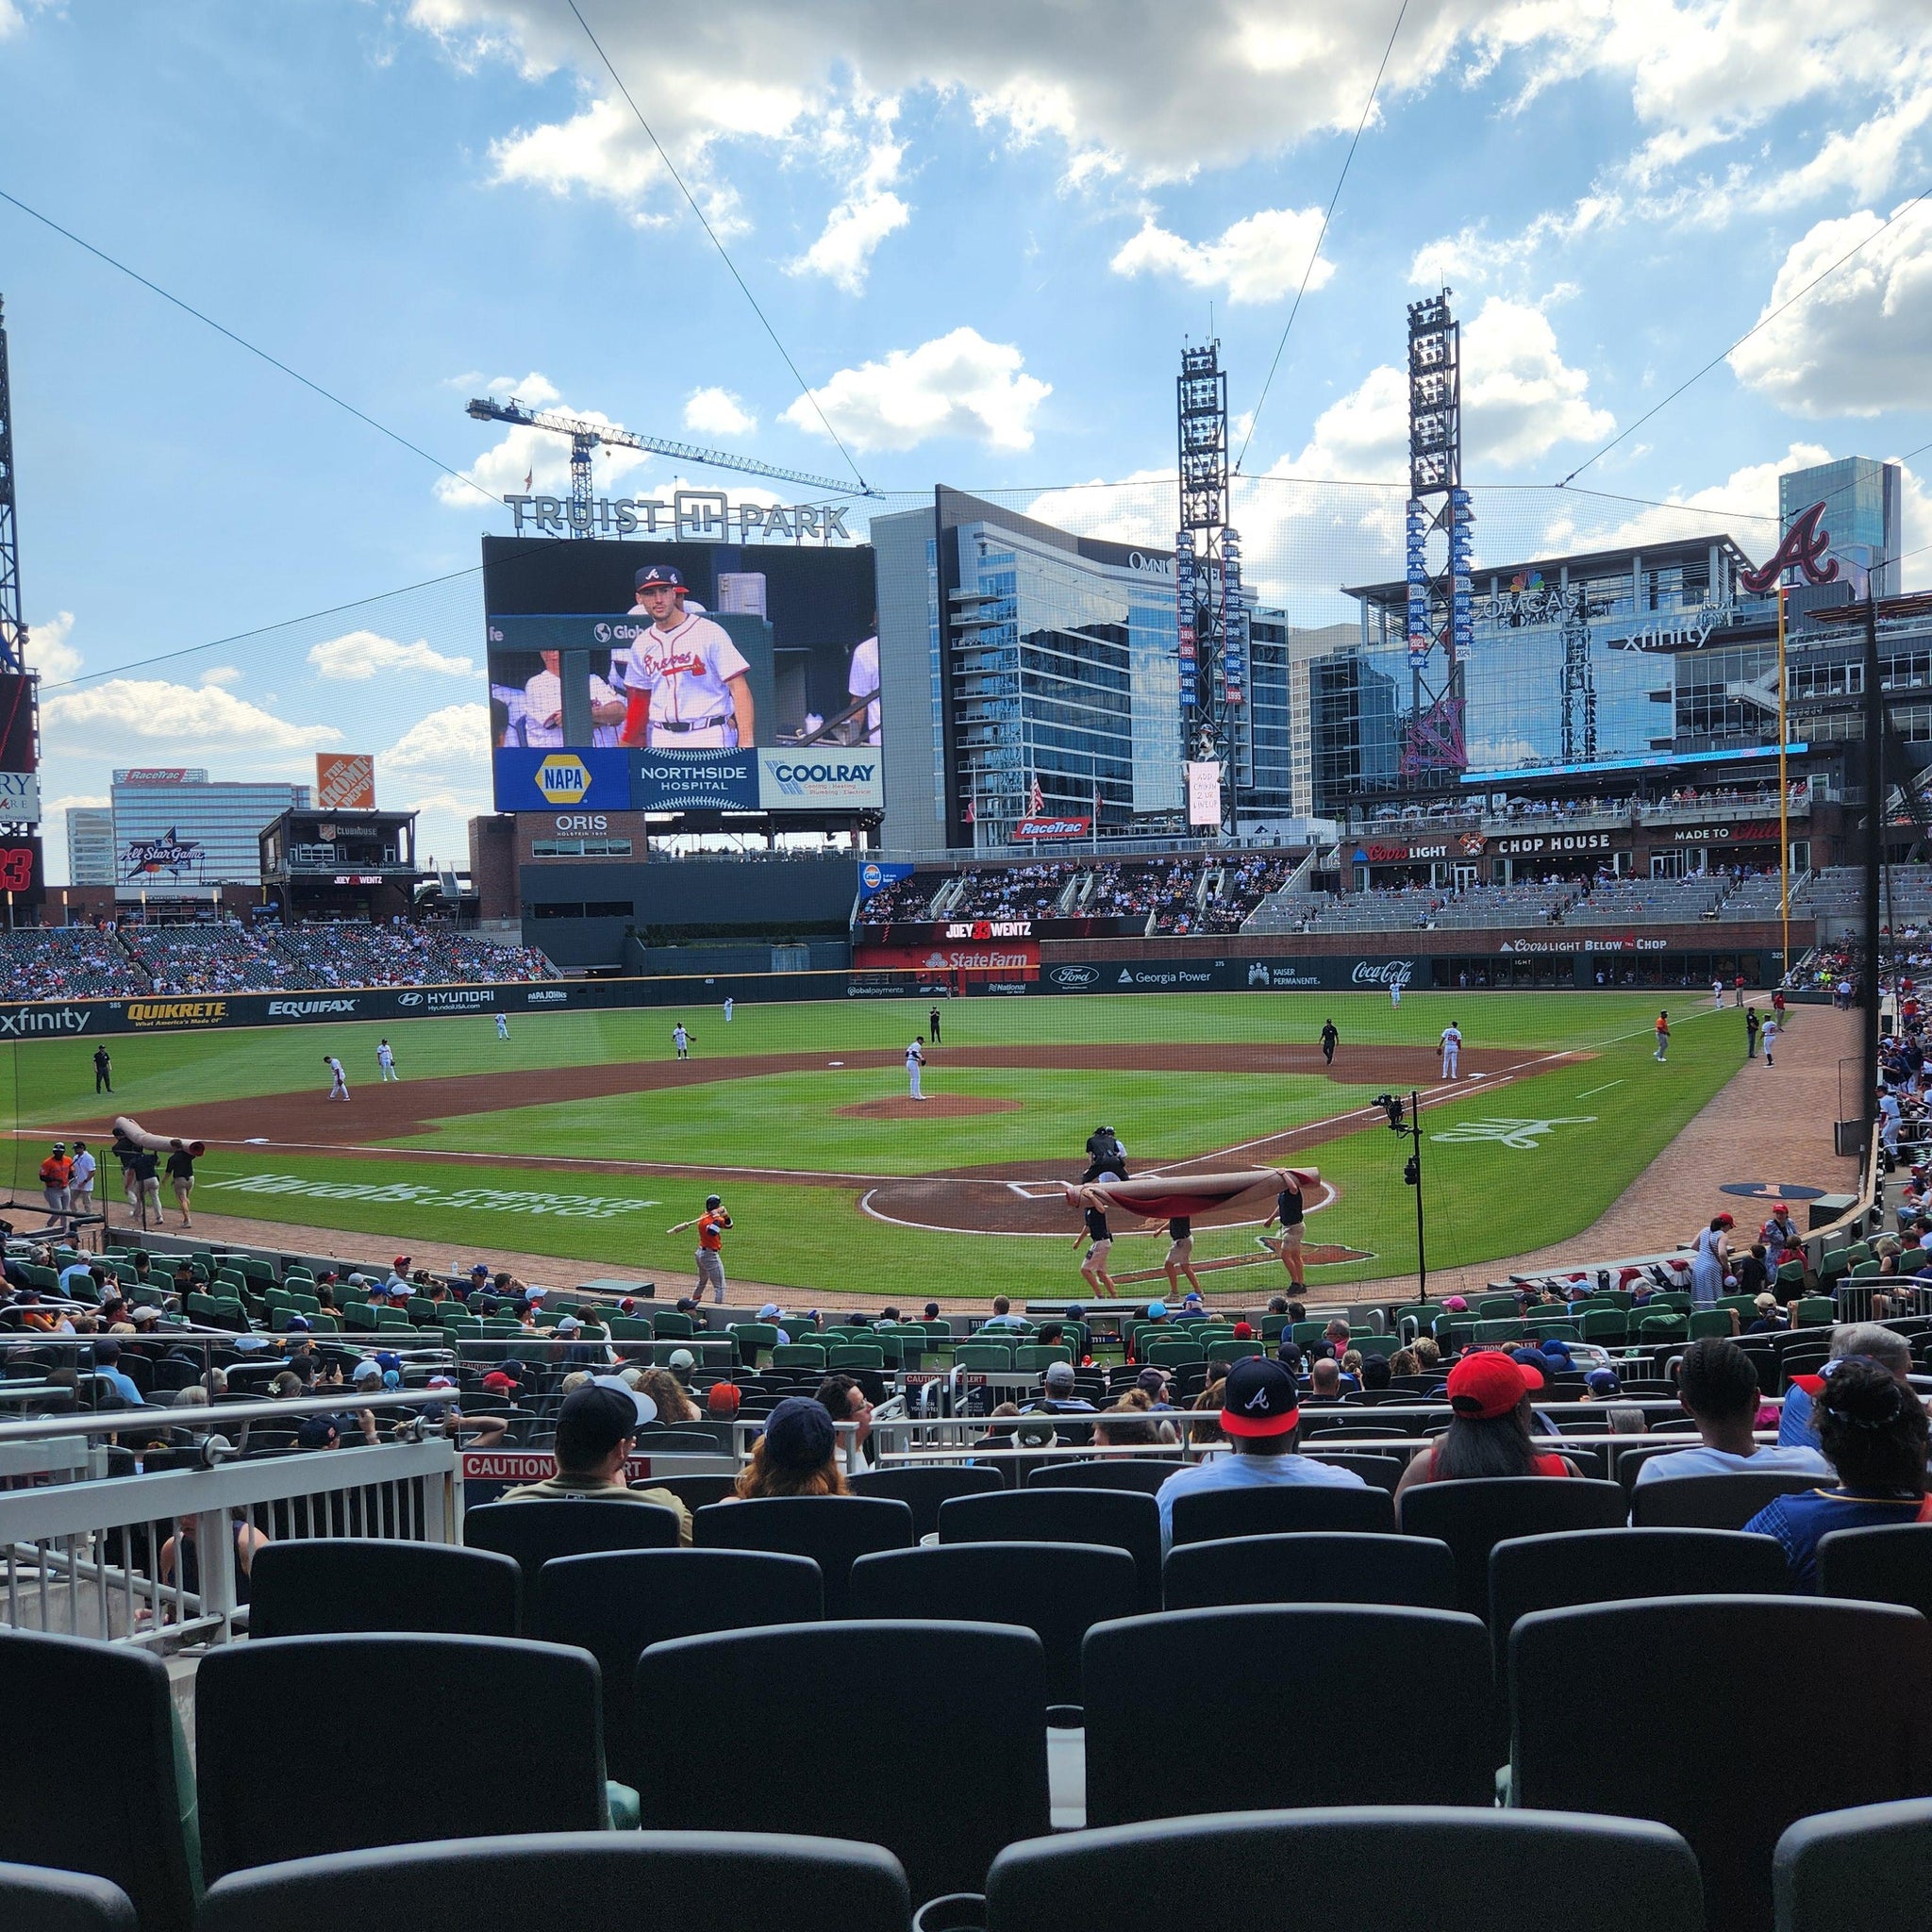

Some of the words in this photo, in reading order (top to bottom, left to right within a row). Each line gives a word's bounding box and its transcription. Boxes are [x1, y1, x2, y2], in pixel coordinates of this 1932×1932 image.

[504, 494, 664, 533] TRUIST
[741, 503, 850, 539] PARK
[1456, 579, 1470, 589] 2012
[1456, 615, 1471, 624] 2020
[1410, 639, 1424, 647] 2021
[1623, 625, 1713, 653] xfinity
[1457, 648, 1470, 658] 2024
[644, 652, 691, 676] Braves
[1410, 656, 1424, 666] 2023
[131, 771, 180, 779] RaceTrac
[545, 769, 583, 790] NAPA
[641, 767, 748, 779] NORTHSIDE
[775, 764, 875, 782] COOLRAY
[319, 756, 373, 808] HOME
[661, 782, 729, 791] HOSPITAL
[556, 815, 608, 830] ORIS
[1021, 822, 1082, 835] RaceTrac
[336, 825, 377, 836] CLUBHOUSE
[1674, 829, 1710, 841] MADE
[1712, 828, 1729, 838] TO
[1498, 837, 1543, 853] CHOP
[1552, 834, 1610, 849] HOUSE
[120, 847, 144, 860] All
[143, 846, 171, 860] Star
[171, 846, 205, 860] Game
[1368, 845, 1408, 860] Coors
[1409, 845, 1447, 858] LIGHT
[334, 875, 350, 884] JOEY
[359, 875, 382, 884] WENTZ
[865, 872, 880, 880] Gulf
[946, 923, 974, 938] JOEY
[973, 921, 991, 940] 33
[991, 922, 1031, 937] WENTZ
[1514, 939, 1548, 952] Coors
[1549, 941, 1580, 952] LIGHT
[1585, 940, 1622, 951] BELOW
[1636, 939, 1667, 950] CHOP
[1772, 951, 1784, 959] 325
[1058, 968, 1091, 982] Ford
[1136, 972, 1176, 984] Georgia
[1179, 971, 1211, 982] Power
[1352, 960, 1414, 984] Coca-Cola
[427, 991, 494, 1004] HYUNDAI
[127, 1002, 226, 1021] QUIKRETE
[268, 999, 357, 1017] EQUIFAX
[1, 1007, 91, 1035] xfinity
[452, 1189, 662, 1210] CHEROKEE
[415, 1196, 628, 1218] CASINOS
[467, 1457, 553, 1475] CAUTION
